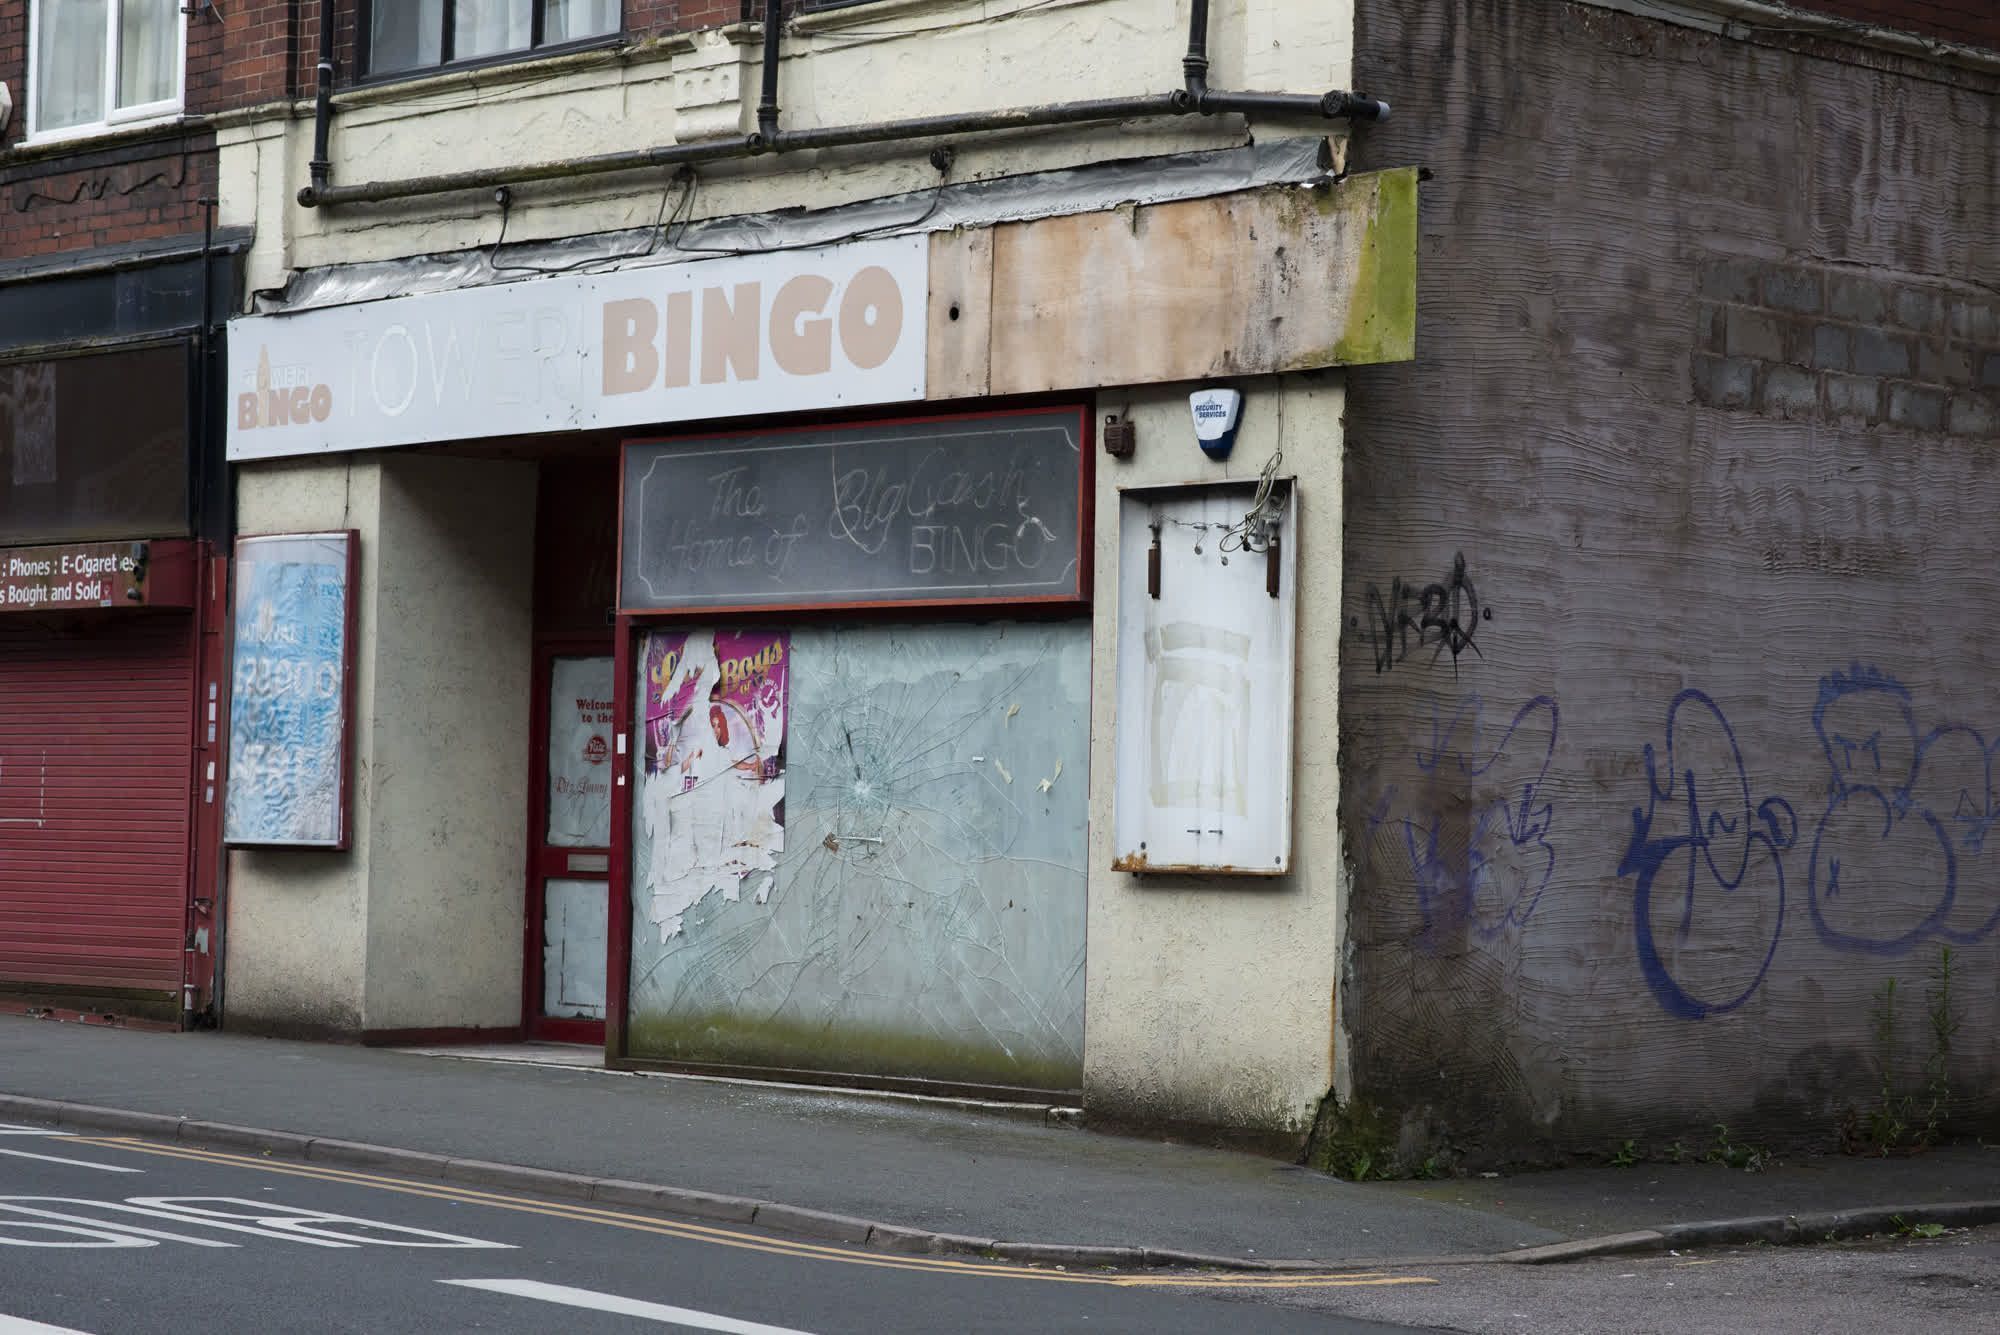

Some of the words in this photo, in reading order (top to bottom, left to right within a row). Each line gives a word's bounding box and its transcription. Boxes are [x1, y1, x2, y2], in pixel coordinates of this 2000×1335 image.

[344, 303, 571, 418] TOWER
[601, 265, 903, 396] BINGO
[238, 384, 332, 431] BINGO
[708, 466, 769, 522] The
[10, 558, 50, 577] Phones
[61, 553, 135, 577] E-Cigaretes
[910, 522, 1046, 575] BINGO
[8, 584, 47, 606] Bought
[51, 582, 72, 600] and
[75, 580, 101, 600] Sold
[720, 641, 783, 698] Boys
[576, 699, 614, 711] Welcom
[582, 713, 592, 723] to
